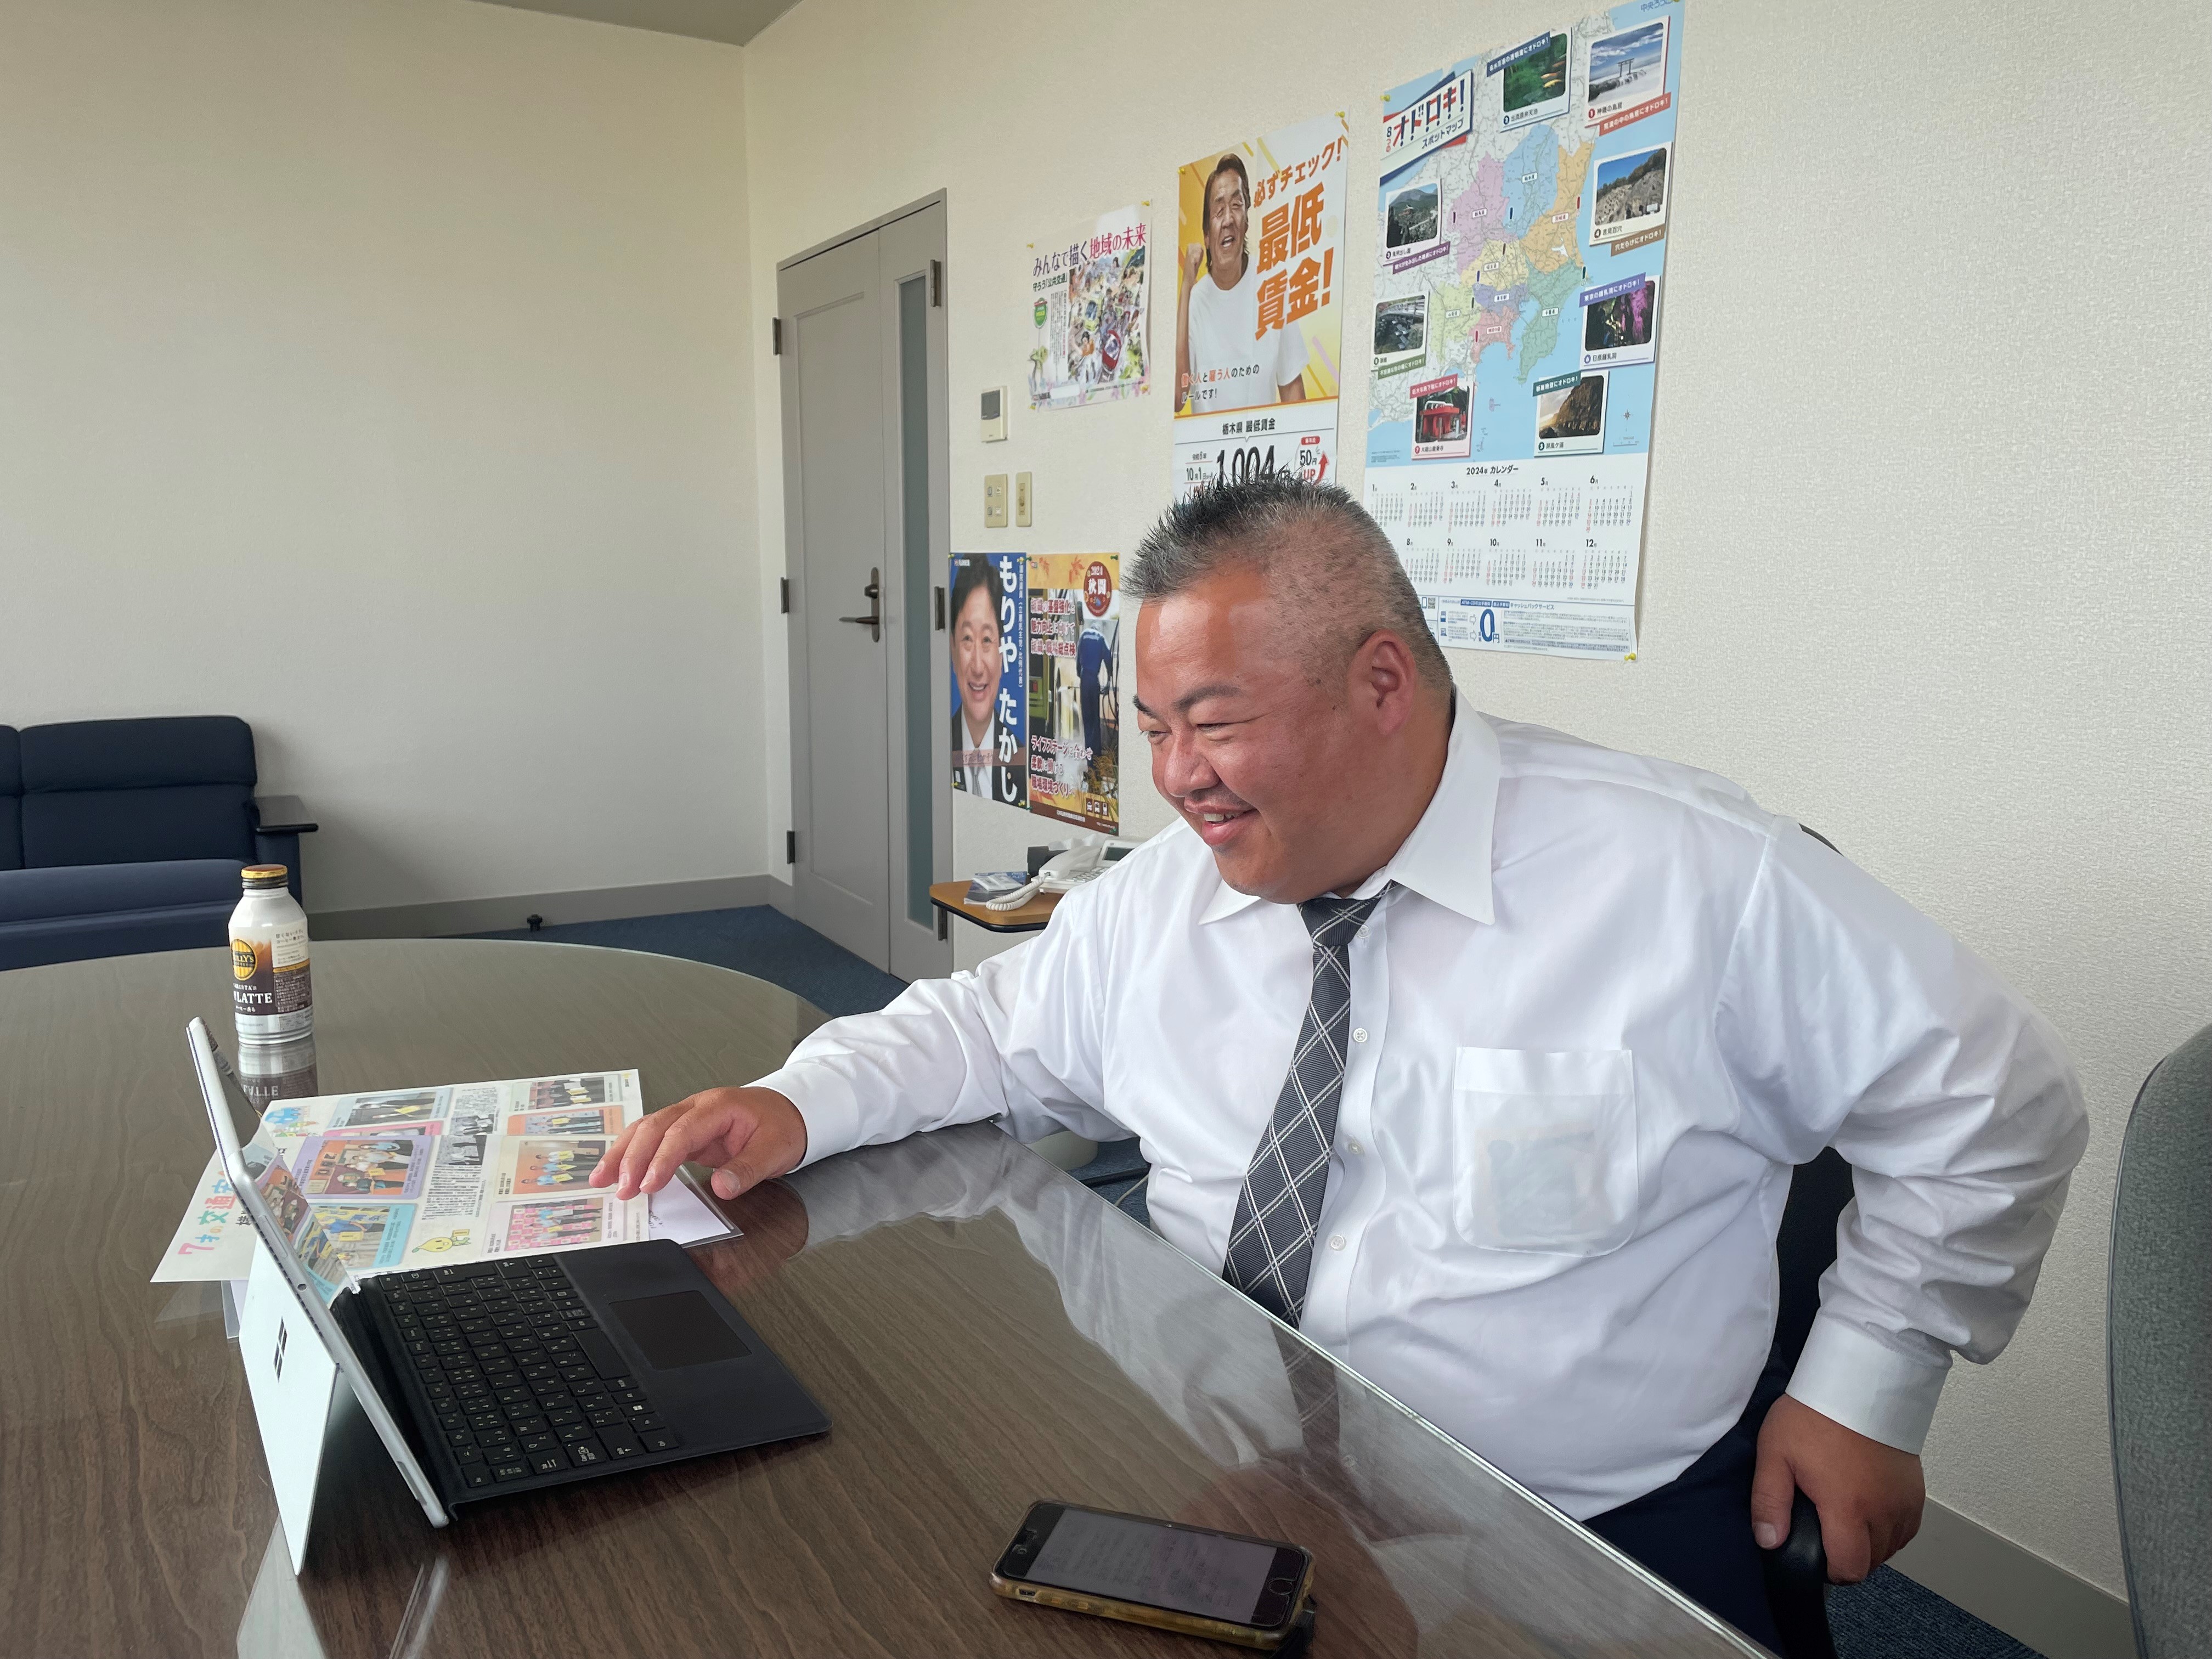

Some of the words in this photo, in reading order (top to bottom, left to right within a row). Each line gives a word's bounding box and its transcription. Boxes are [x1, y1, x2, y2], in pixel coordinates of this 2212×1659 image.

[1421, 117, 1464, 149] スポットマップ
[1254, 137, 1342, 208] 必ずチェック!
[1032, 223, 1147, 277] みんなで描く地域の未来
[1257, 182, 1325, 274] 最低
[1255, 247, 1334, 341] 賃金!
[1181, 387, 1217, 403] ルールです!
[1222, 422, 1243, 435] 栃木県
[1245, 418, 1276, 432] 最低賃金
[1304, 469, 1316, 481] UP
[1489, 465, 1519, 475] カレンダー
[998, 556, 1017, 673] もりや
[1480, 608, 1495, 642] 0
[1492, 633, 1499, 643] 円
[999, 687, 1018, 802] たかし
[177, 1170, 237, 1255] 7才の交通安
